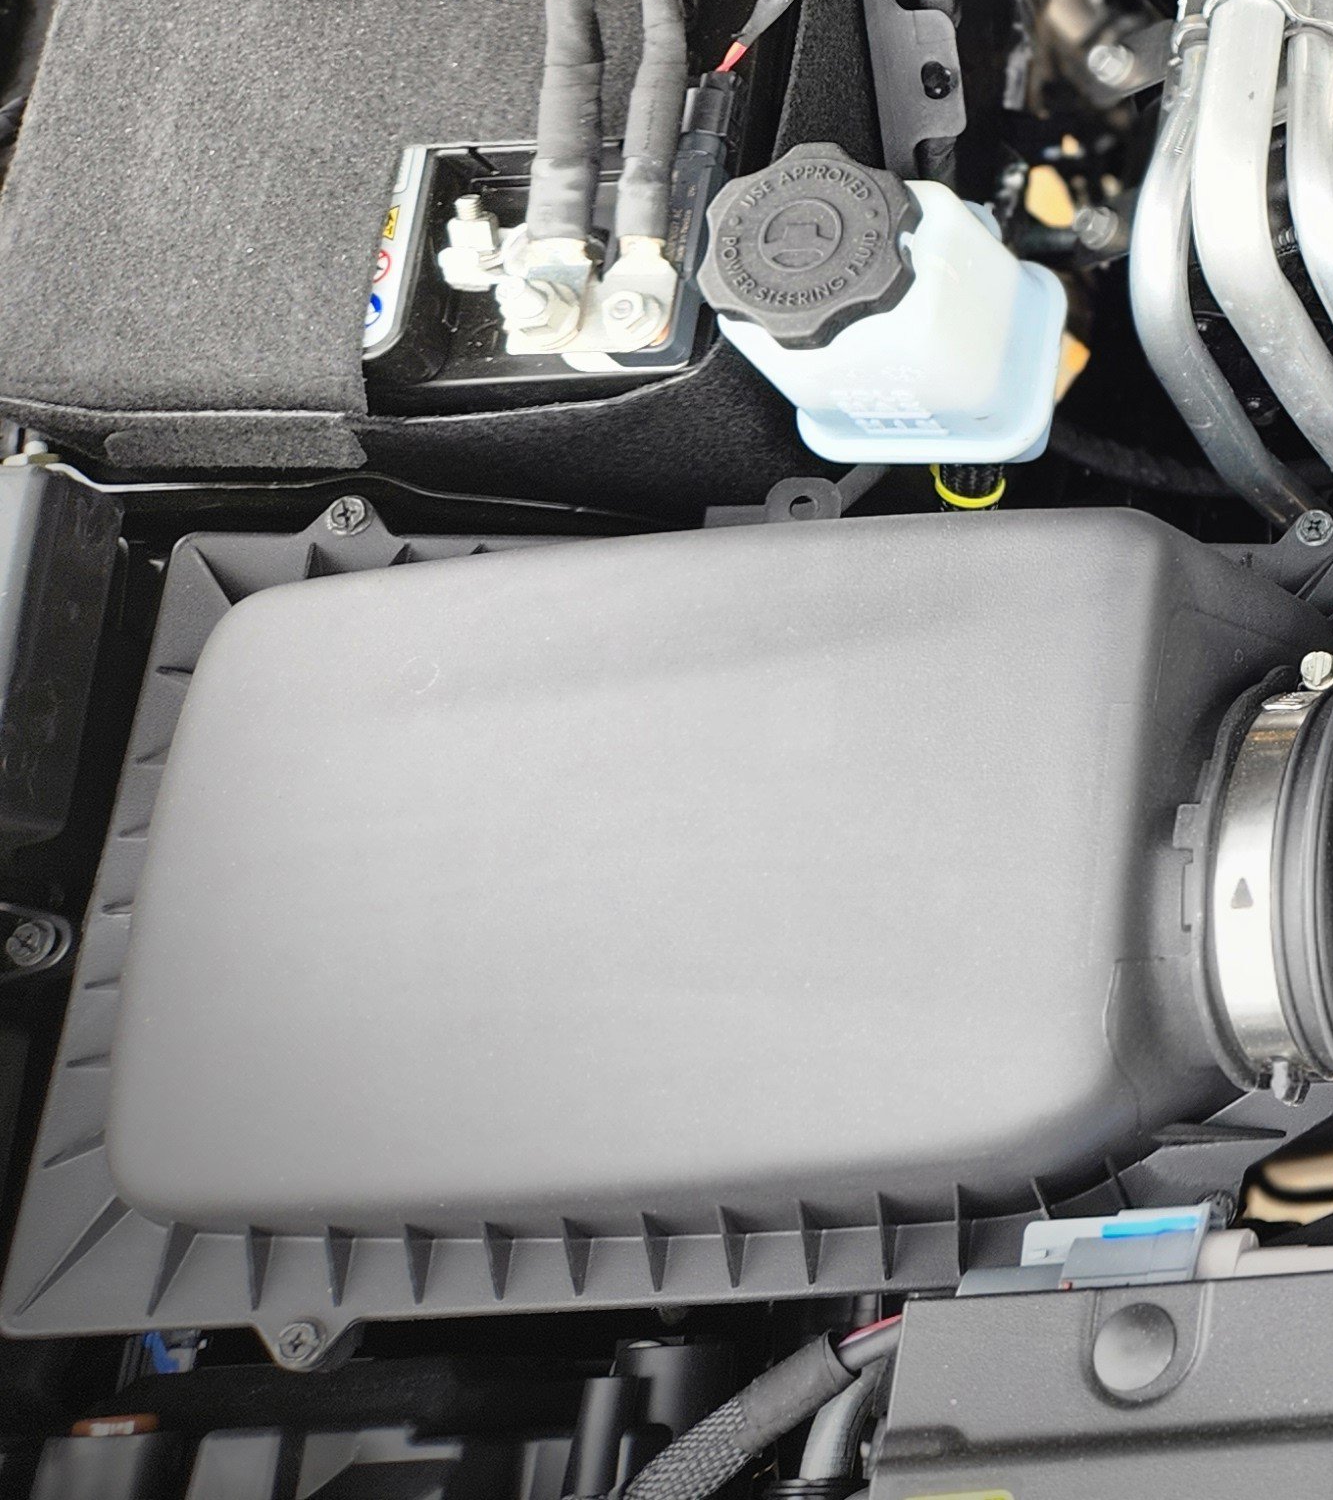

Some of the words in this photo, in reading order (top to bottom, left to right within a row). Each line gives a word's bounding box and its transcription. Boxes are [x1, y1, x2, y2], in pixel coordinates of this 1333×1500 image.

[739, 180, 775, 209] USE
[777, 165, 872, 202] APPROVED
[721, 235, 757, 295] POWER
[754, 275, 848, 307] STEERING
[844, 229, 880, 277] FLUID
